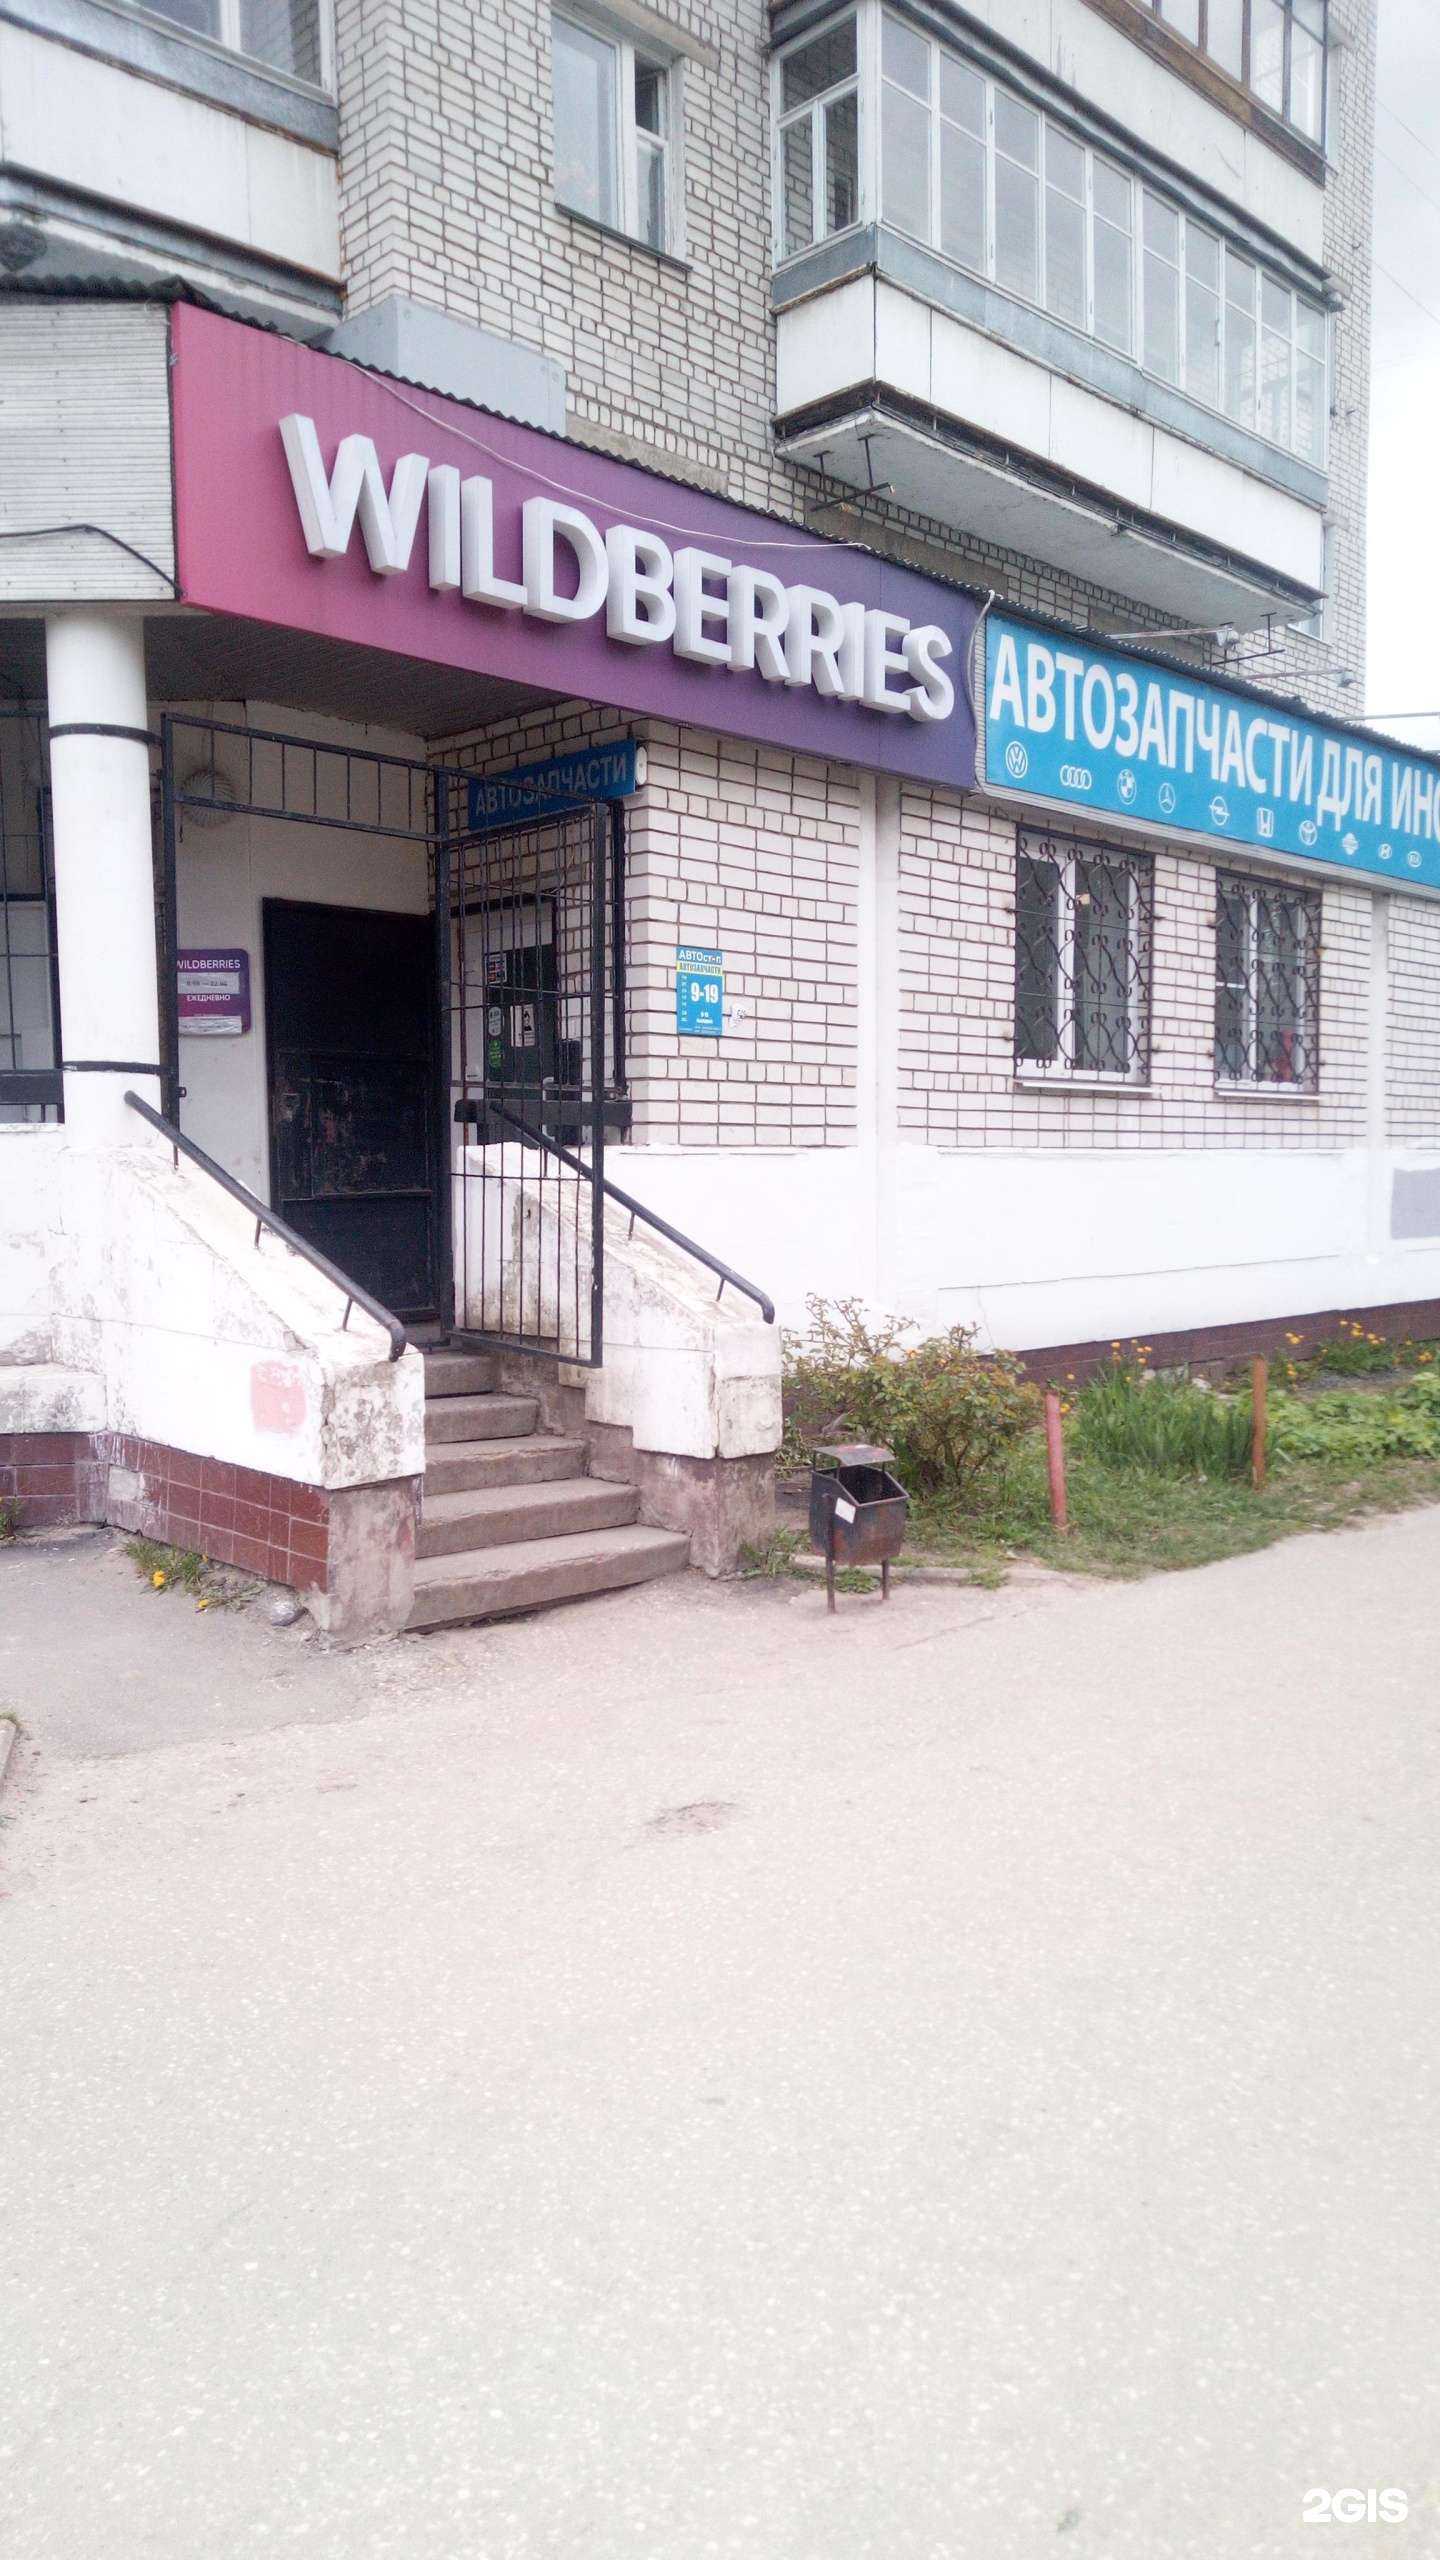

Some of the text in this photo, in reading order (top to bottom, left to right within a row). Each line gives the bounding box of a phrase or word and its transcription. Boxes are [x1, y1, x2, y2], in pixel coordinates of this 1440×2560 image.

[279, 413, 955, 723] WILDBERRIES
[475, 752, 628, 817] АВТОЗАПЧАСТИ
[989, 633, 1315, 807] АВТОЗАПЧАСТИ
[1316, 738, 1384, 832] ДЛЯ
[690, 982, 719, 1004] 9-19
